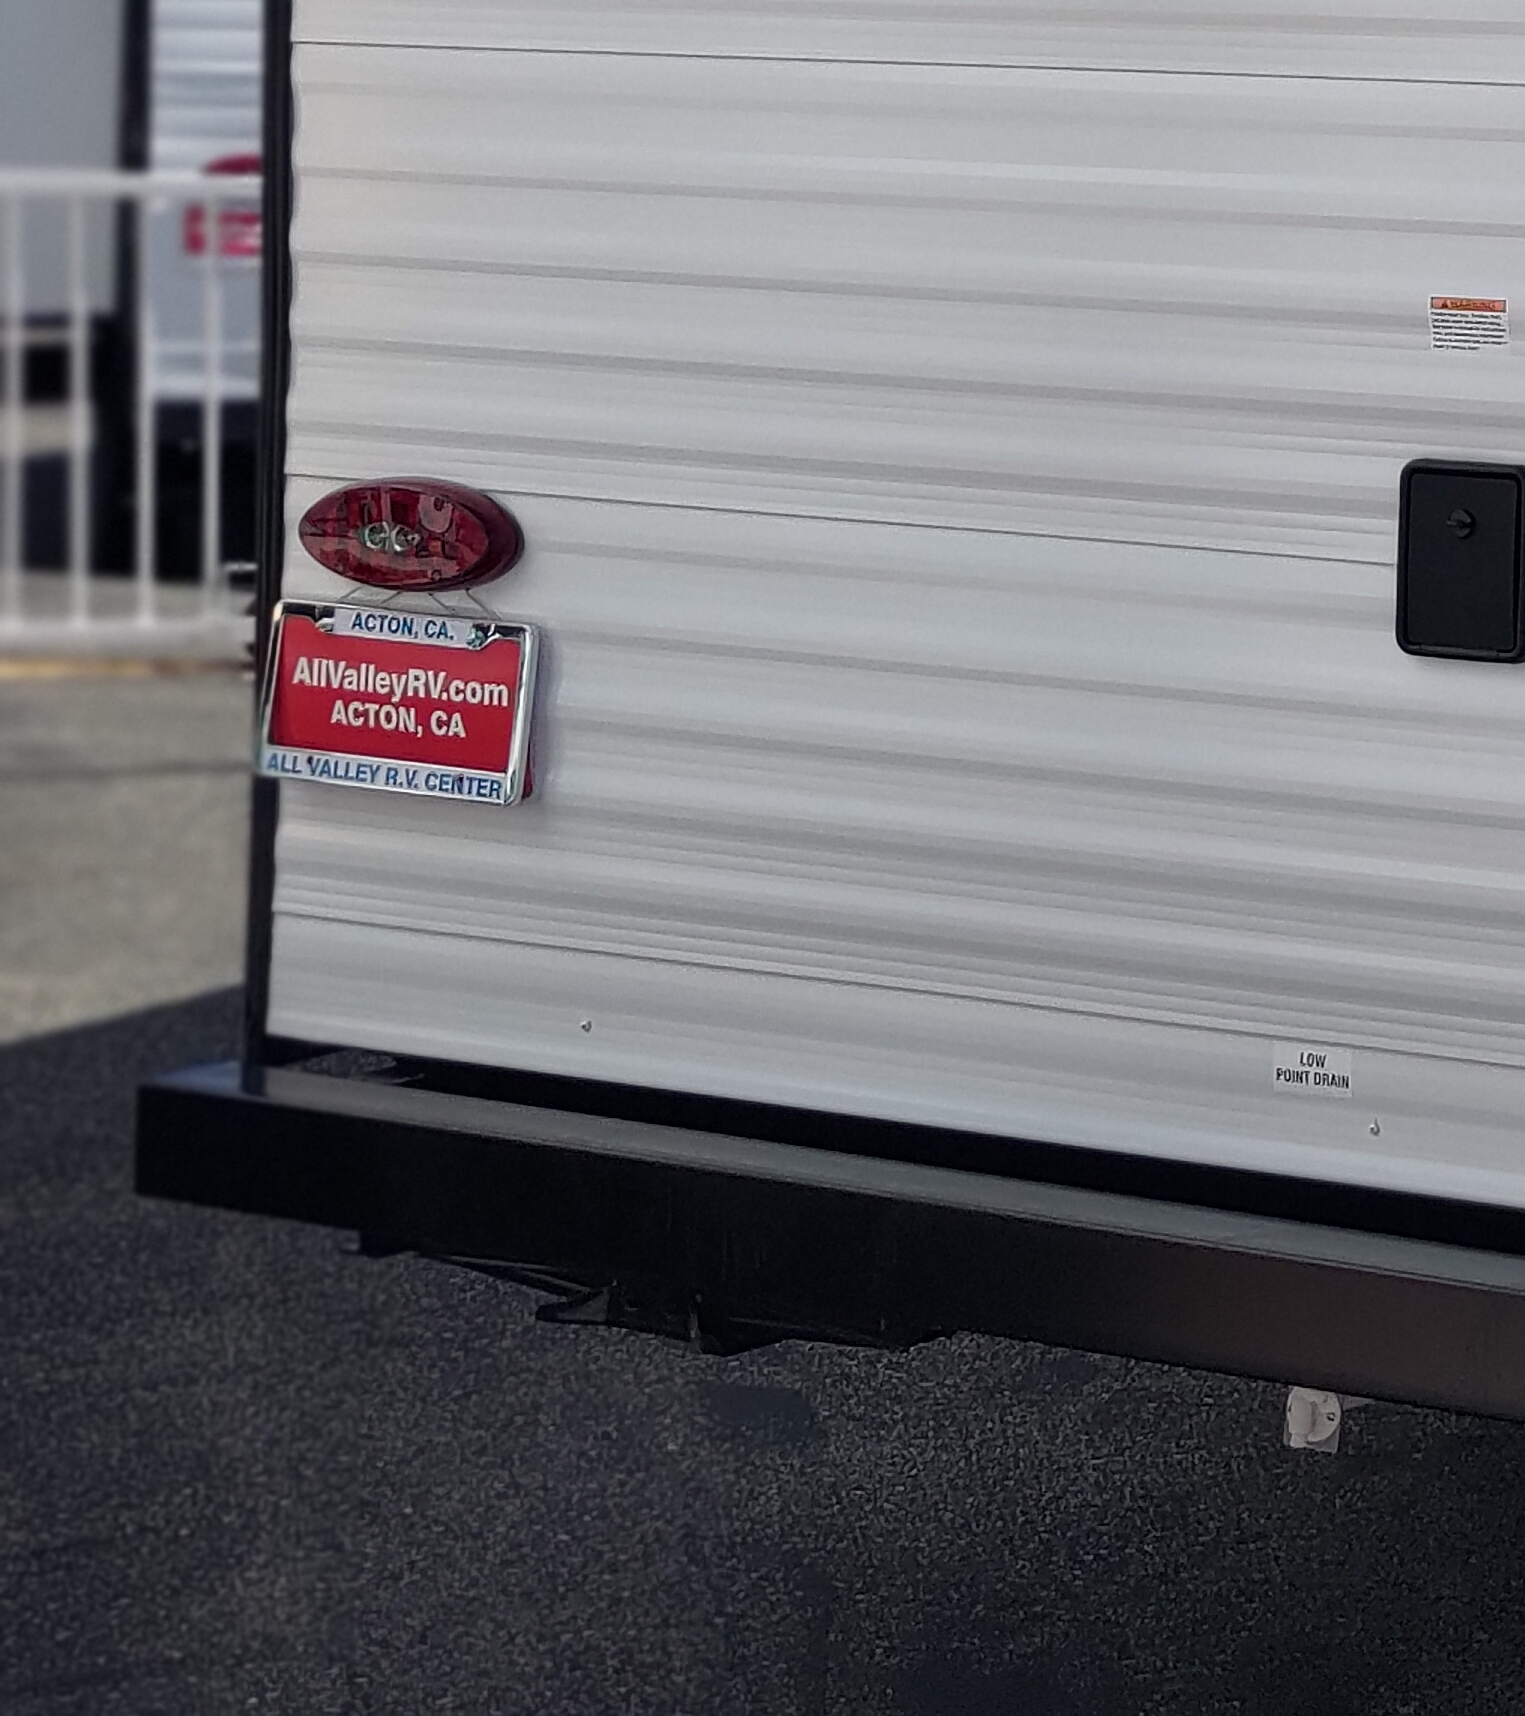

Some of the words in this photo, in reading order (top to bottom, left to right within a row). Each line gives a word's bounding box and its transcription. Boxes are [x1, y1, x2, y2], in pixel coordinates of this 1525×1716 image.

[350, 611, 419, 639] ACTON,
[423, 619, 455, 641] CA.
[292, 656, 509, 707] AllValleyRV.com
[330, 699, 423, 738] ACTON,
[430, 710, 466, 738] CA
[267, 751, 303, 775] ALL
[307, 755, 382, 784] VALLEY
[385, 764, 419, 788] R.V.
[424, 771, 502, 800] CENTER
[1299, 1051, 1327, 1068] LOW
[1275, 1067, 1310, 1086] POINT
[1313, 1071, 1350, 1089] DRAIN
